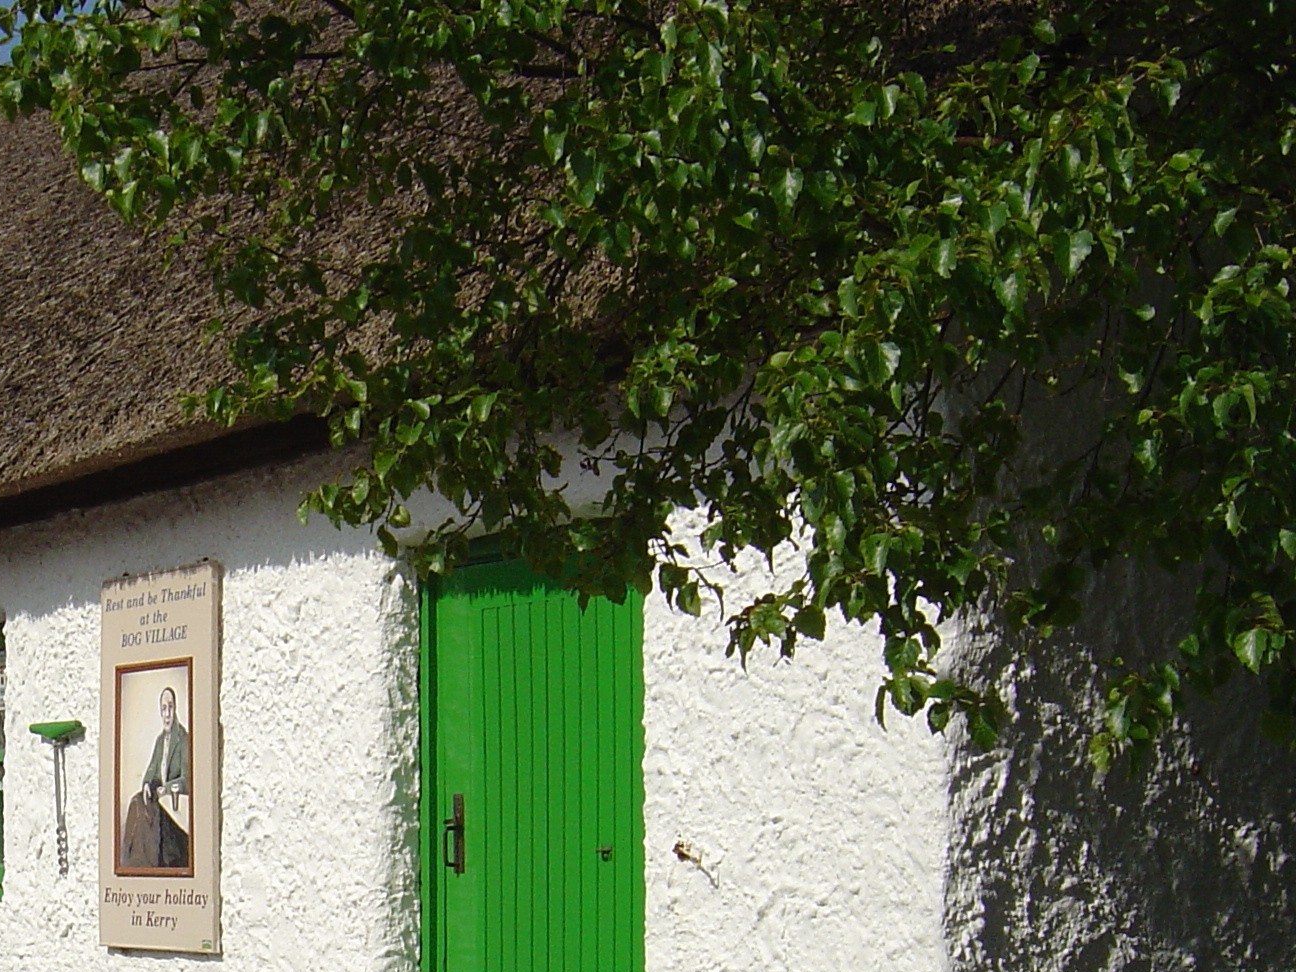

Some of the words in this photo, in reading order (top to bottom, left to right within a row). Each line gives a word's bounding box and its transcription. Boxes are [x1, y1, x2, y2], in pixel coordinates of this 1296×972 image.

[105, 598, 124, 613] Rest
[126, 593, 145, 609] and
[147, 591, 158, 606] be
[161, 582, 206, 603] Thankful
[139, 614, 150, 626] at
[153, 609, 168, 624] the
[121, 632, 142, 648] BOG
[145, 624, 188, 644] VILLAGE
[104, 887, 134, 907] Enjoy
[136, 892, 161, 907] your
[164, 888, 209, 908] holiday
[131, 910, 142, 926] in
[146, 910, 178, 930] Kerry
